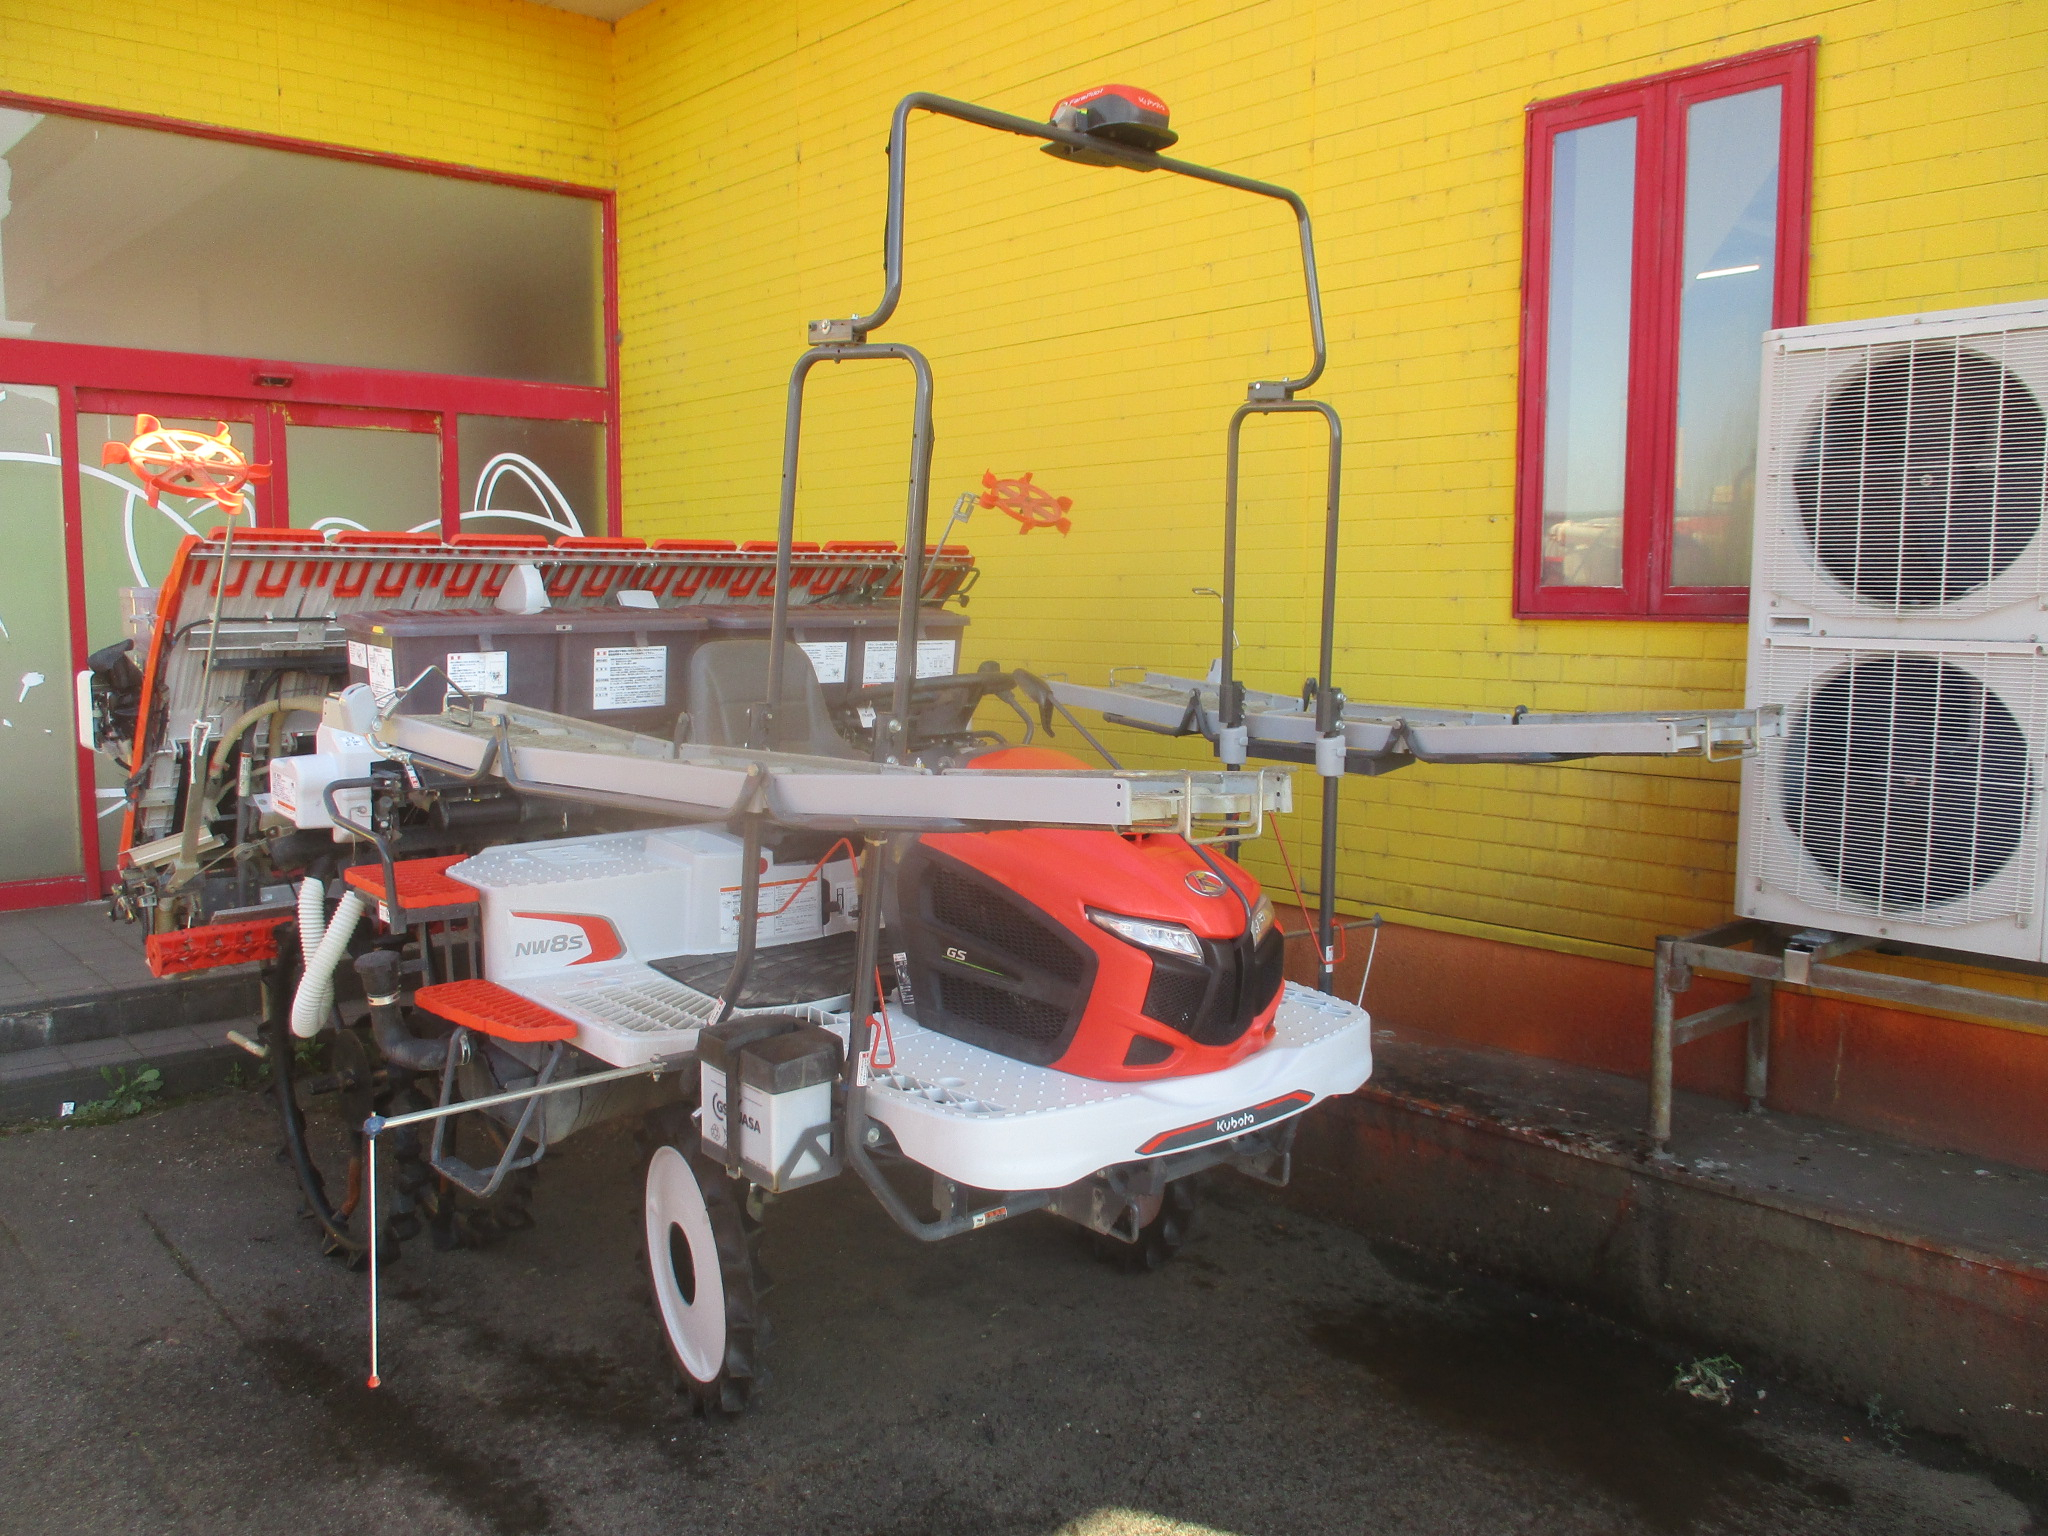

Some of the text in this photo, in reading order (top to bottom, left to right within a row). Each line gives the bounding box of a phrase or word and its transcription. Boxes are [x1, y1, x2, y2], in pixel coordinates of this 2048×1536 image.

[515, 934, 584, 957] NW8S
[946, 947, 967, 961] GS
[1216, 1112, 1255, 1132] Kubota
